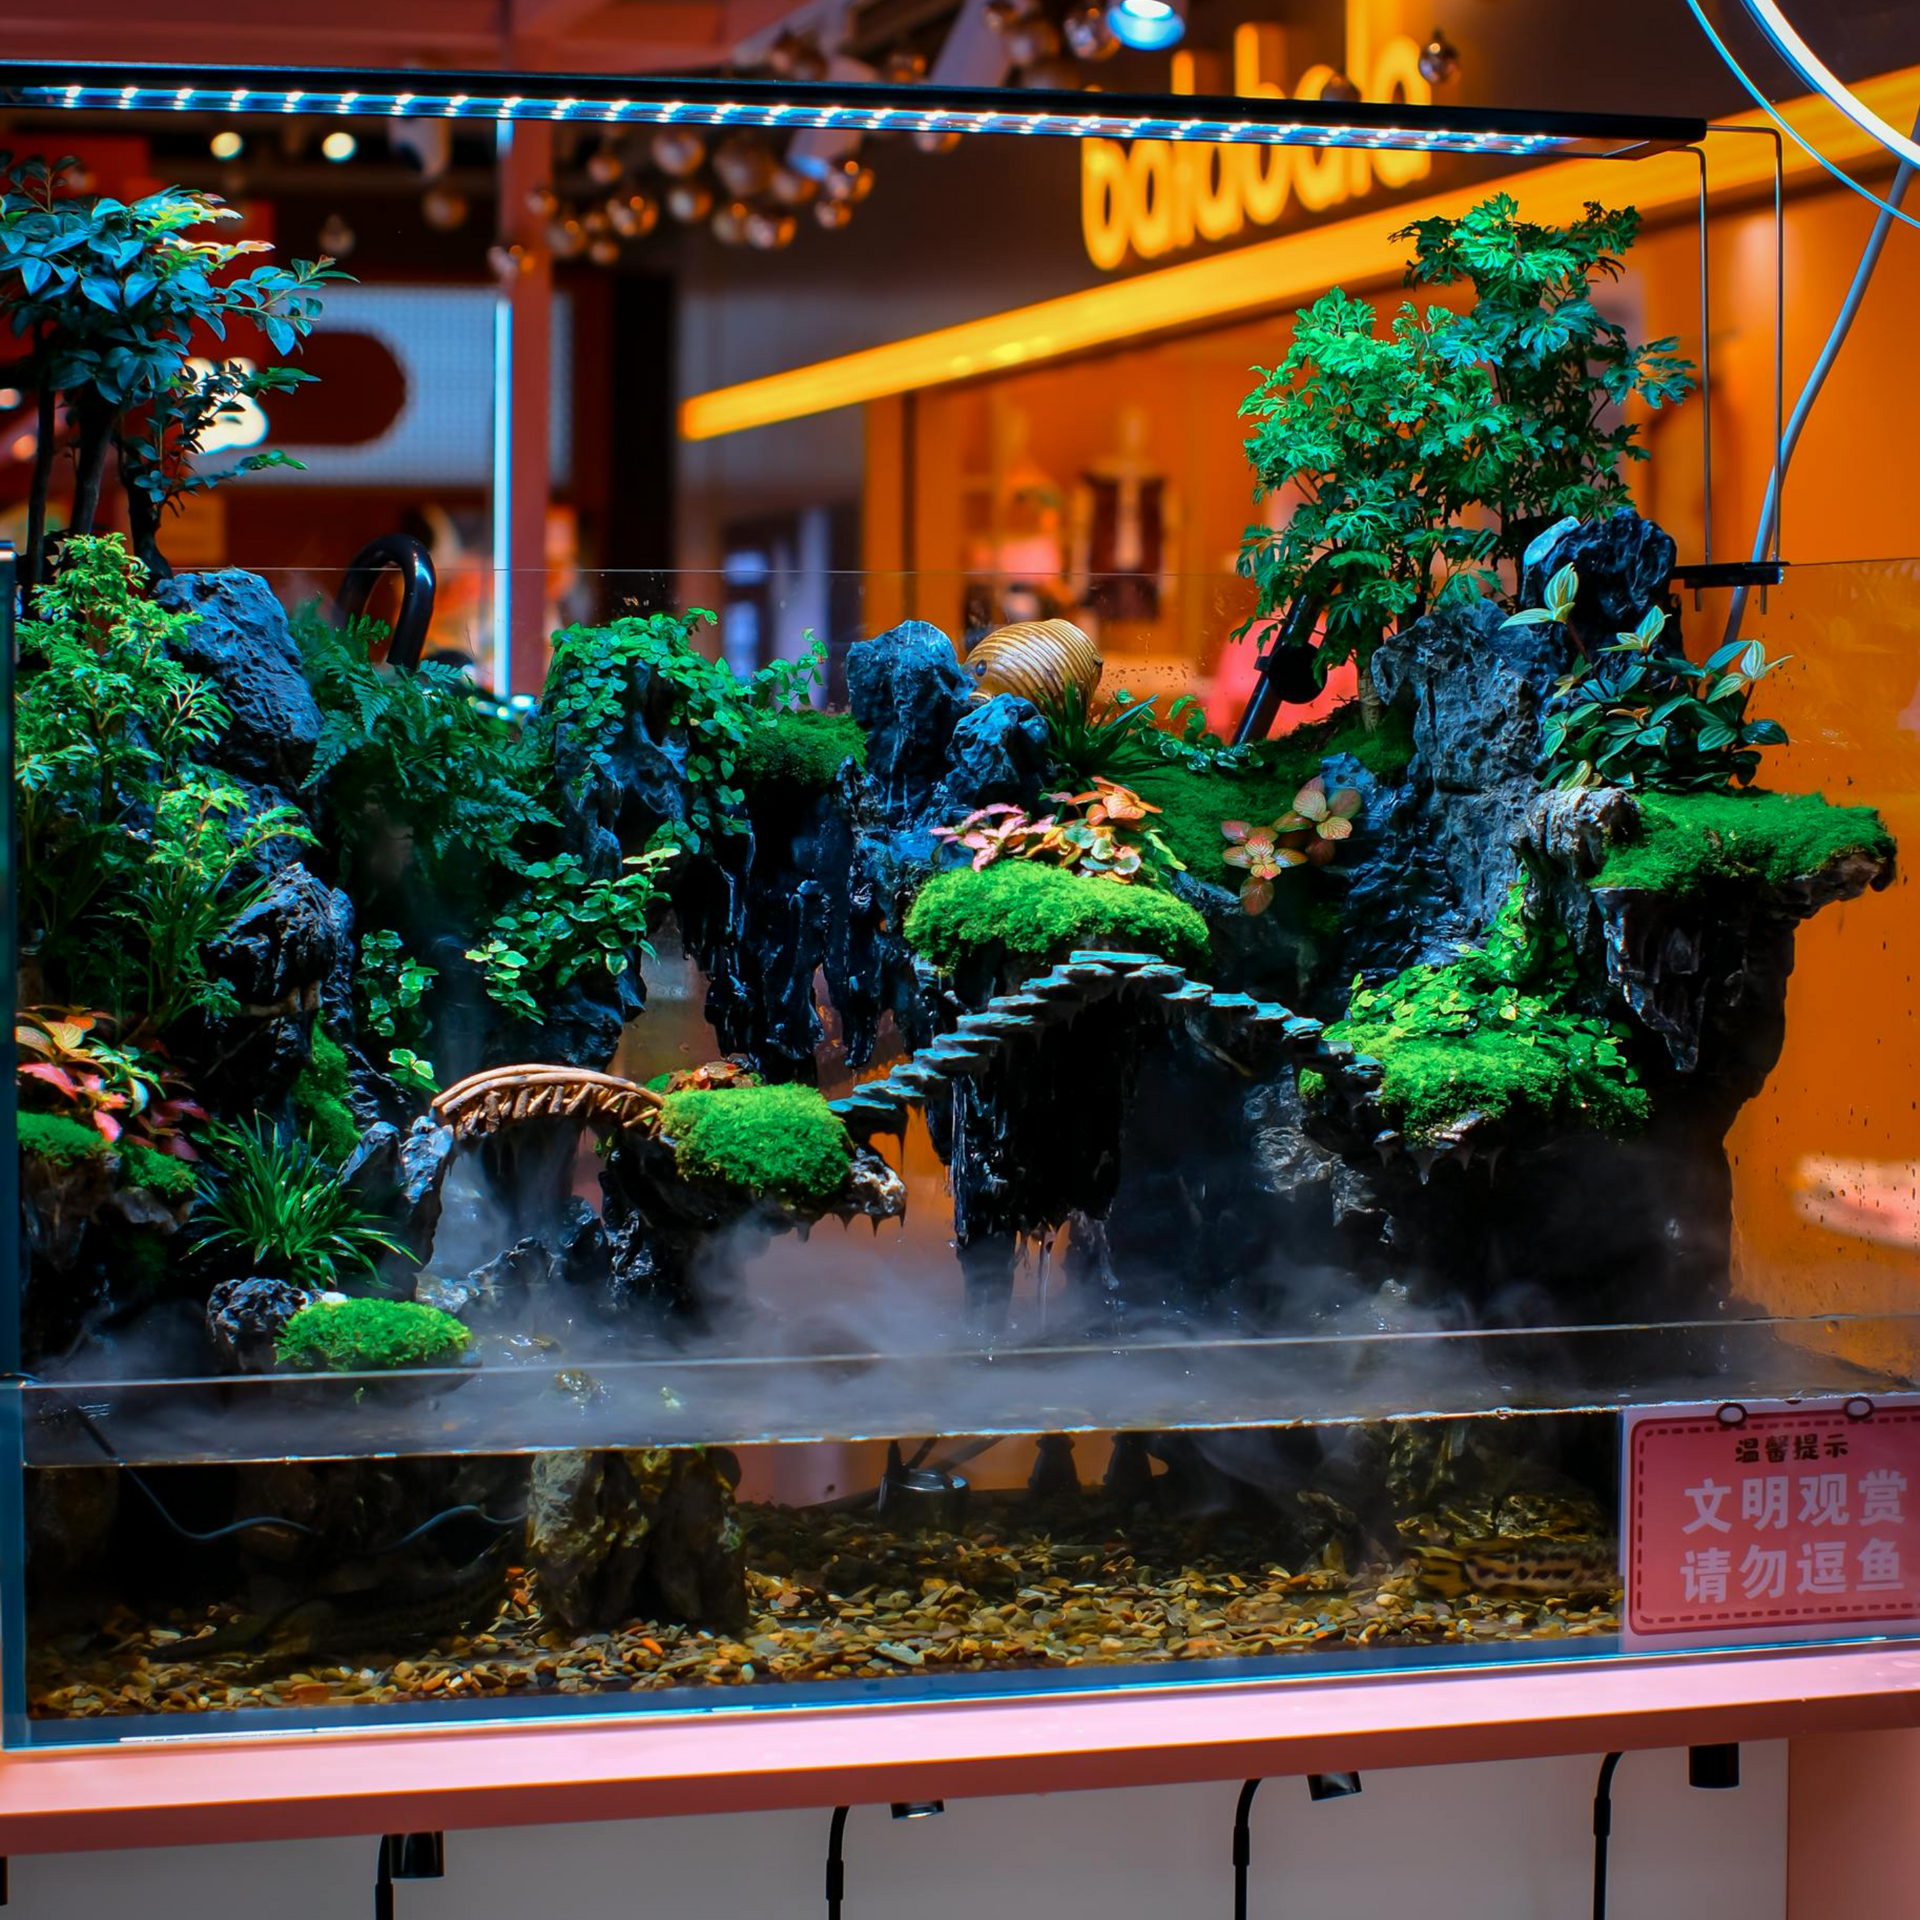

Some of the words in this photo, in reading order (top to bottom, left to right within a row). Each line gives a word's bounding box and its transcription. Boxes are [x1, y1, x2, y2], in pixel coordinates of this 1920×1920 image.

[1735, 1433, 1848, 1463] 温馨提示
[1682, 1469, 1907, 1534] 文明观赏
[1680, 1538, 1904, 1604] 请勿逗鱼
